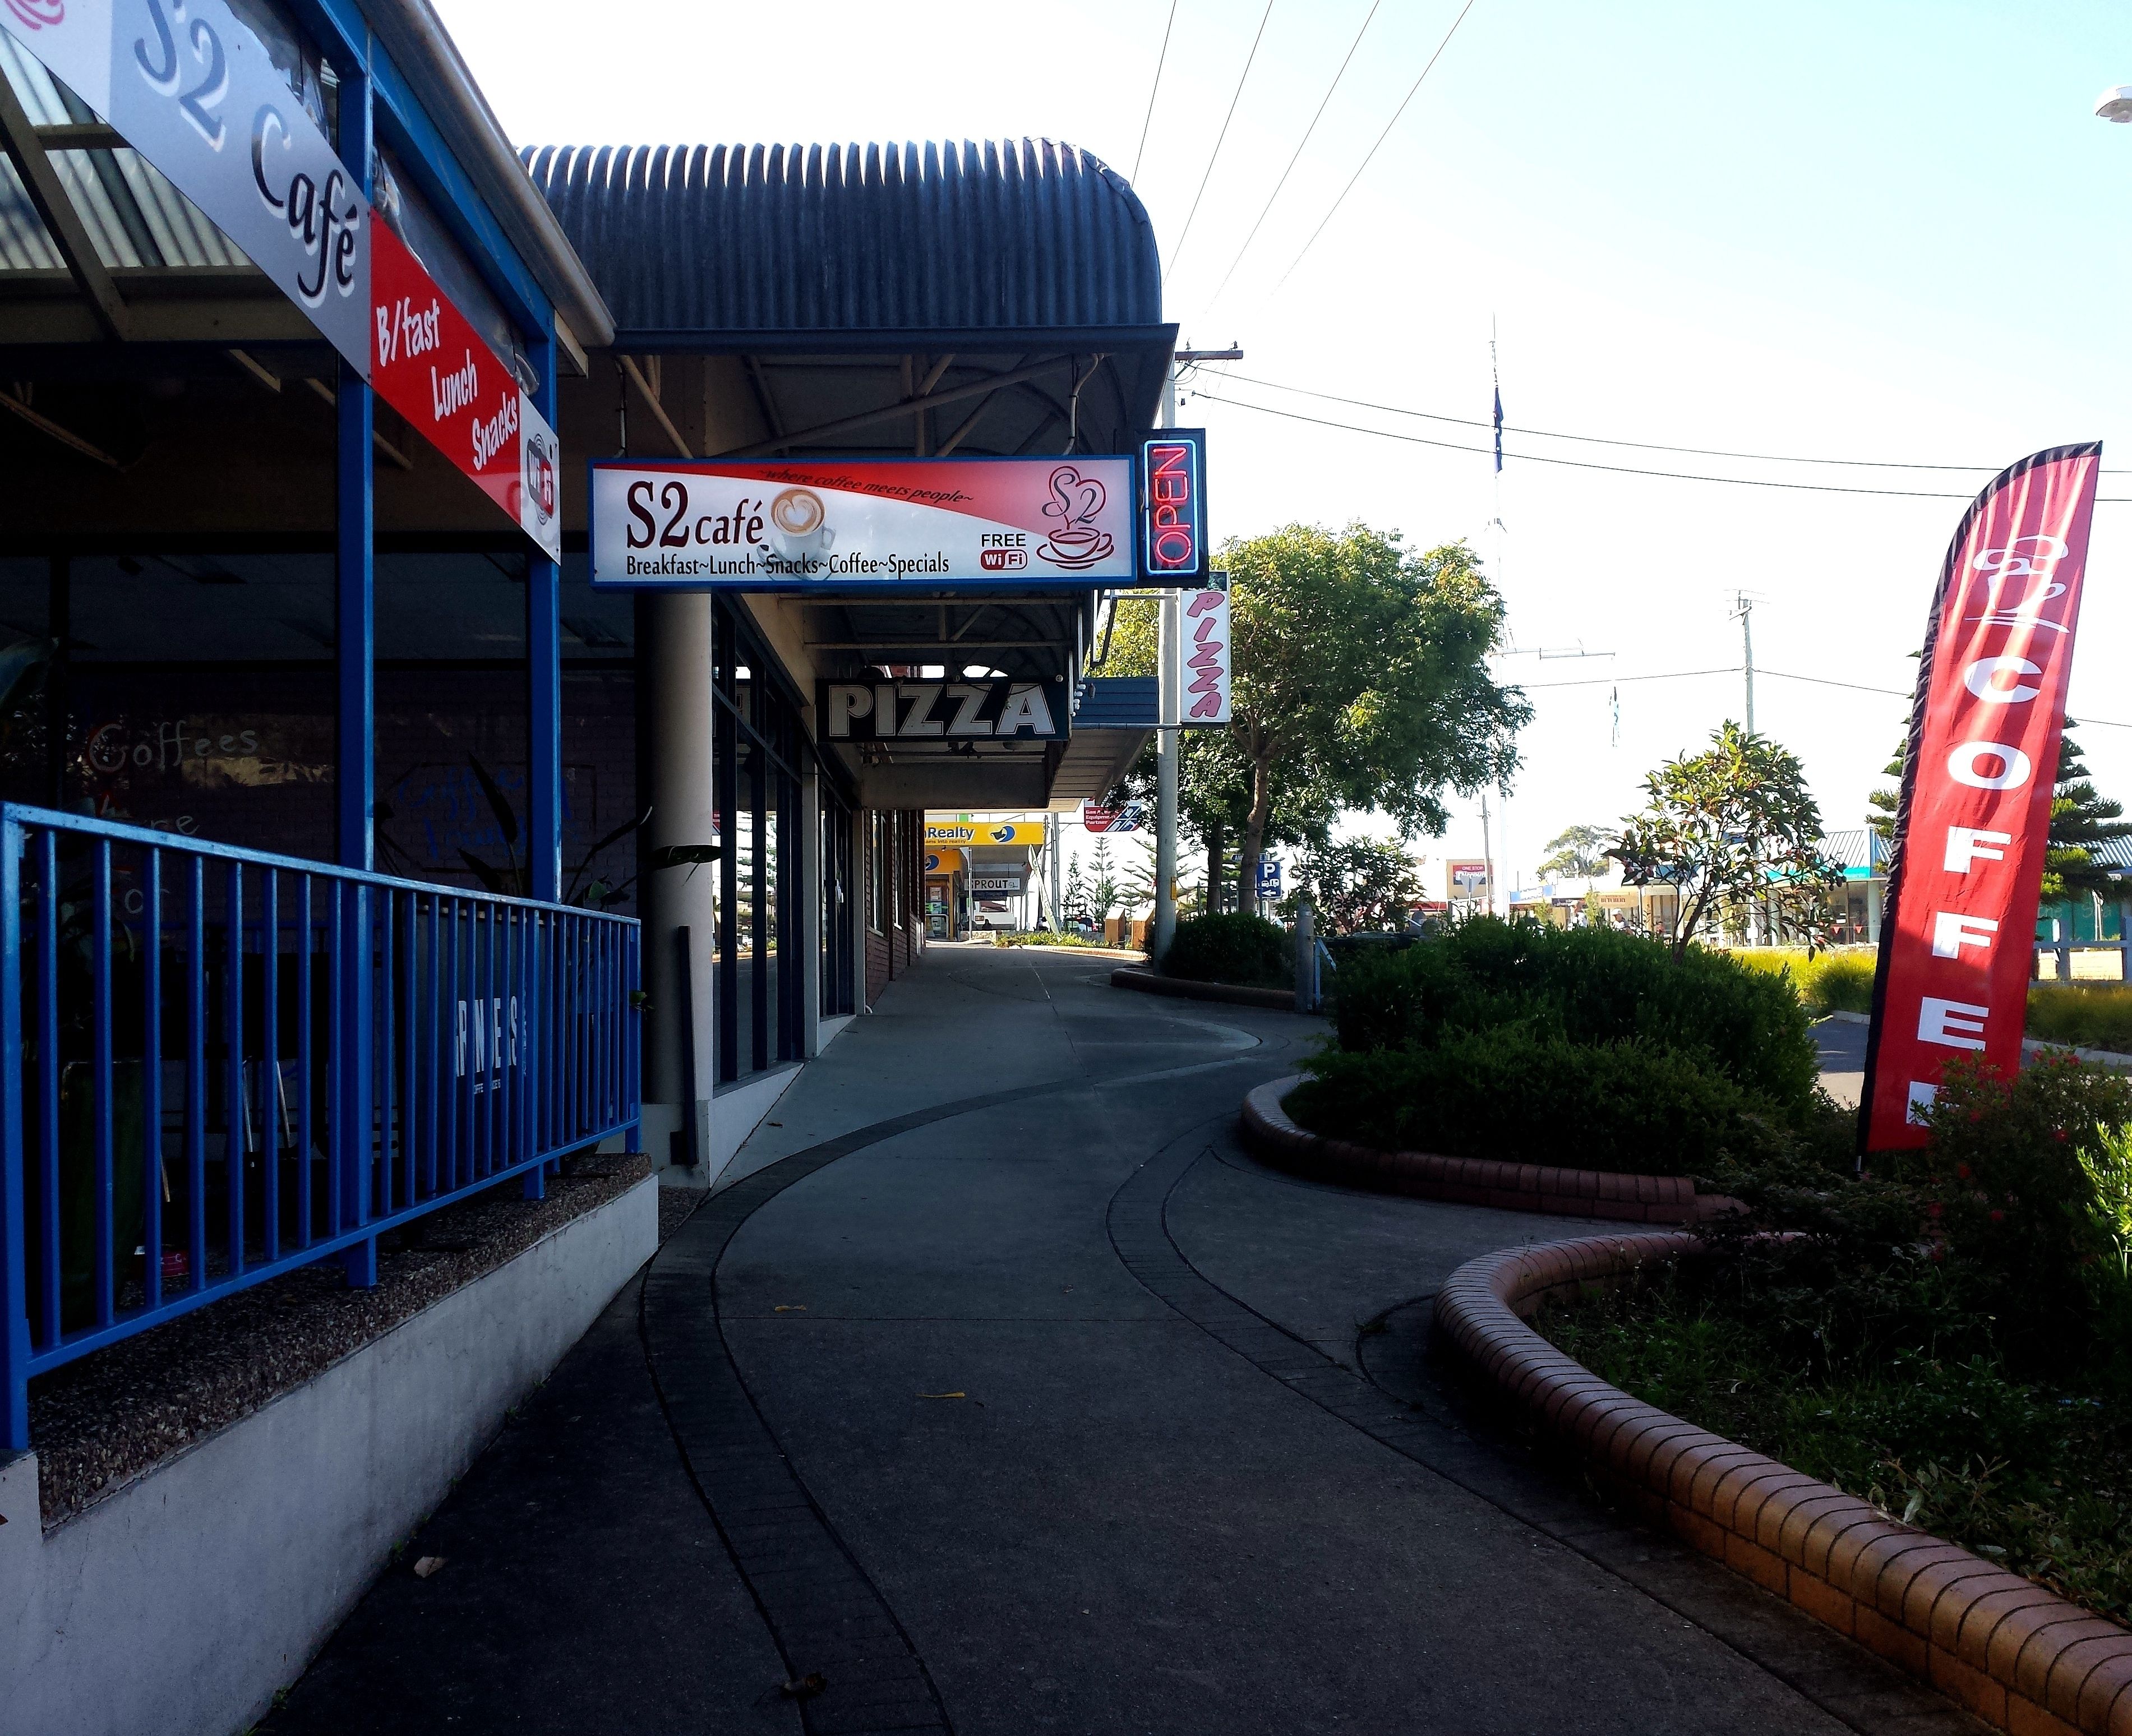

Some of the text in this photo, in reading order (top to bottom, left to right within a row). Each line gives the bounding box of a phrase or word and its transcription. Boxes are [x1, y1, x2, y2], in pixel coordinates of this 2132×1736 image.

[251, 103, 359, 301] Café
[376, 296, 441, 367] B/fast
[431, 348, 478, 422] Lunch
[472, 391, 519, 471] Snacks
[814, 474, 862, 490] coffee
[863, 483, 912, 496] meets
[1041, 473, 1097, 524] S2
[1154, 445, 1192, 564] OPEN
[695, 498, 764, 544] café
[981, 533, 1027, 547] FREE
[1187, 592, 1224, 718] PIZZA
[828, 684, 1055, 737] PIZZA
[968, 880, 1008, 889] PROUT
[1263, 863, 1276, 878] P
